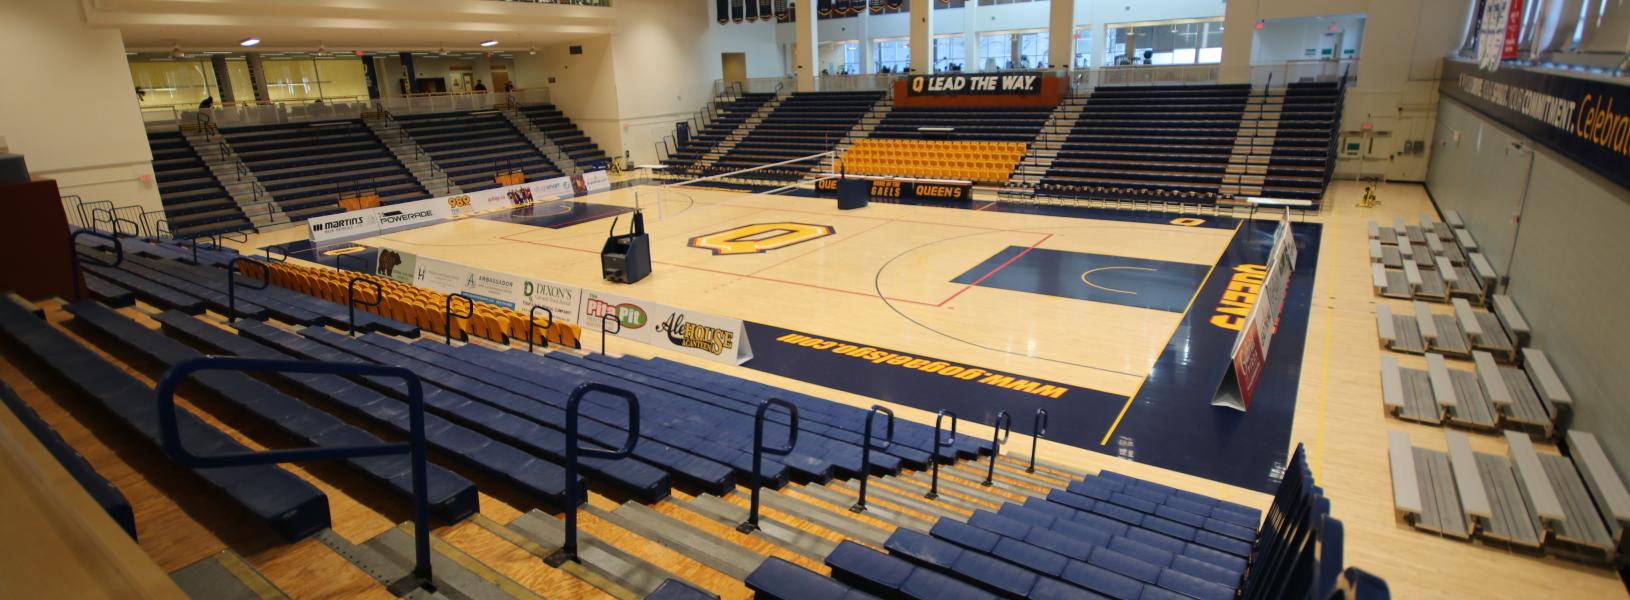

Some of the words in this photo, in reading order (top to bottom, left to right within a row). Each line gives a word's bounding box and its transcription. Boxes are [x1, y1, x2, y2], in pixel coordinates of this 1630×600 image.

[912, 76, 924, 93] Q
[928, 77, 965, 91] LEAD
[970, 76, 998, 90] THE
[1002, 75, 1037, 90] WAY.
[1577, 94, 1630, 156] Celebra
[870, 186, 901, 197] GAELS
[380, 209, 433, 225] POWERADE
[686, 221, 837, 256] Q
[618, 306, 641, 325] Pit
[776, 333, 1069, 399] www.gogaelsgo.com
